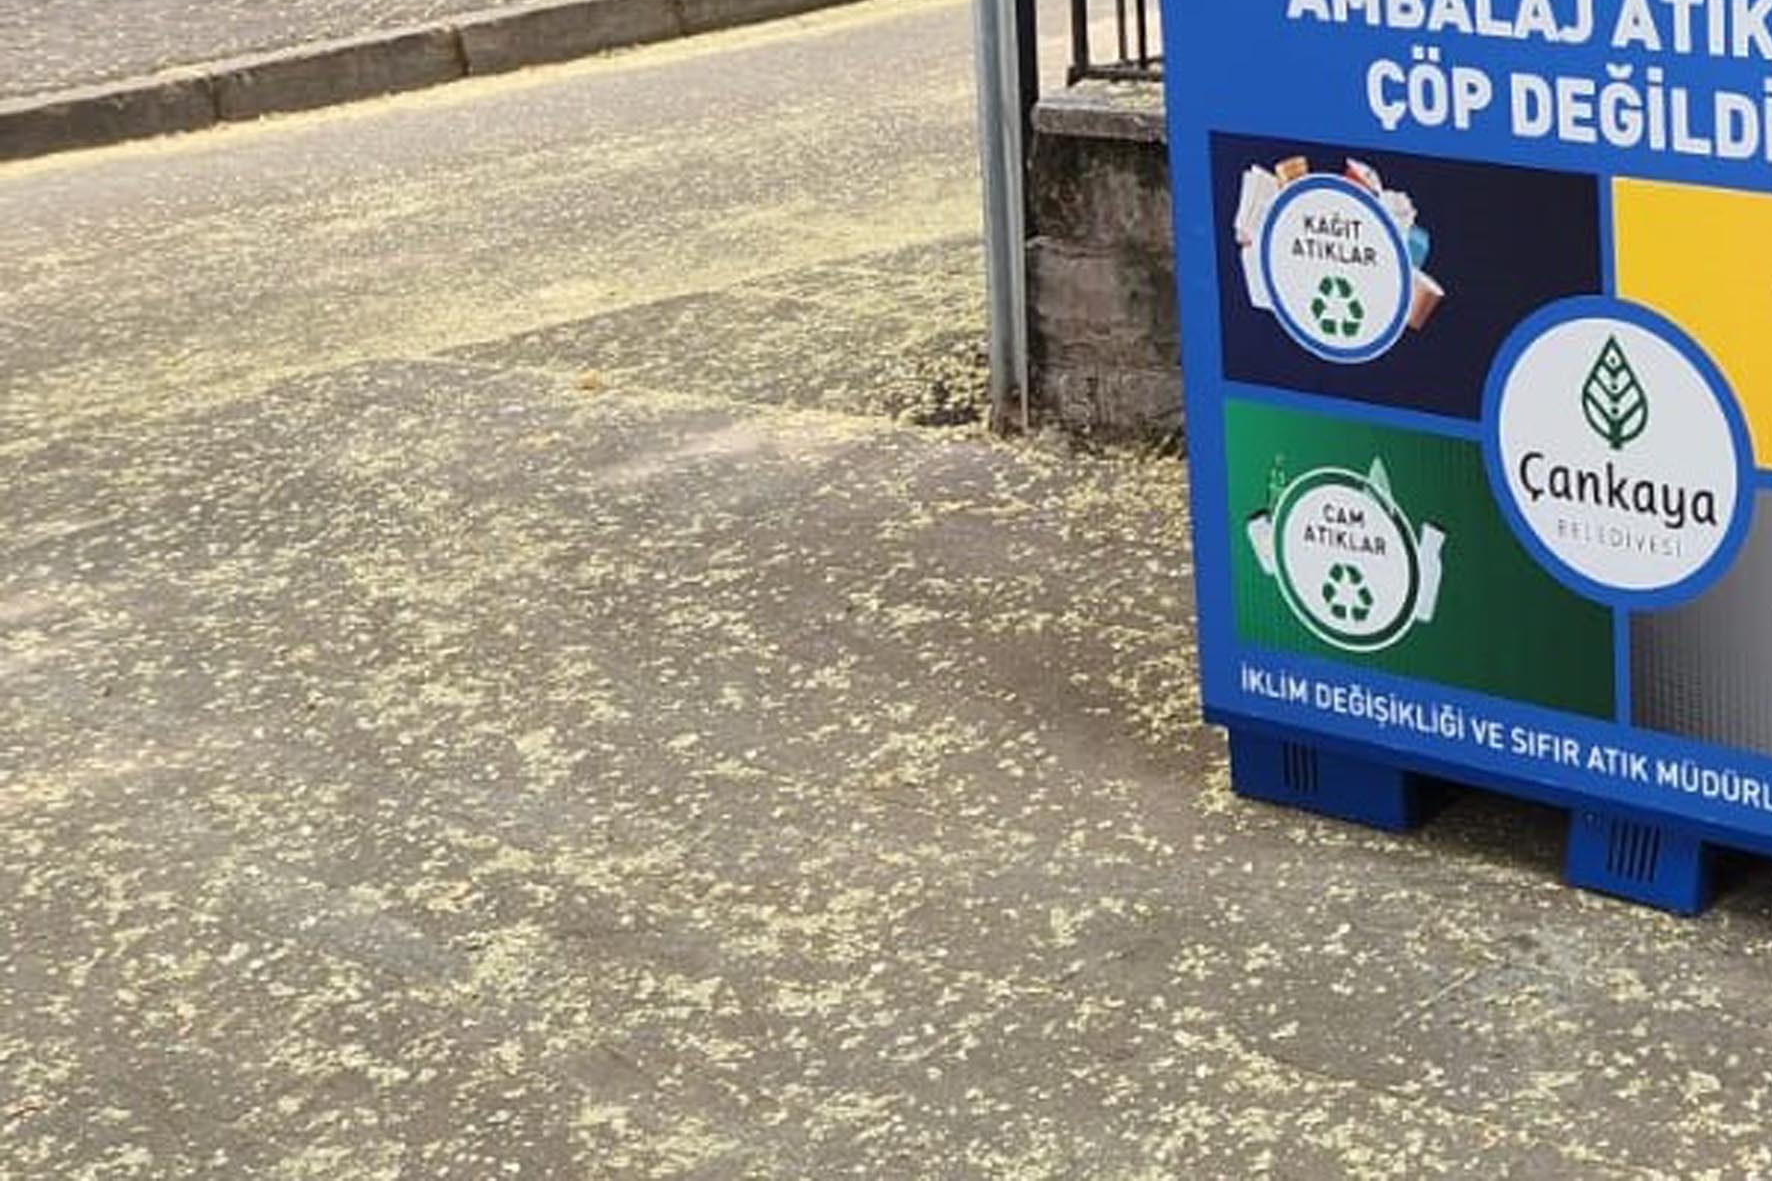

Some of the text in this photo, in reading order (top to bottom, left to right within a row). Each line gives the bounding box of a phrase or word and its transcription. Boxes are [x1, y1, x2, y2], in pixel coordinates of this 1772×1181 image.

[1366, 45, 1493, 132] ÇÖP
[1304, 210, 1363, 241] KAĞIT
[1291, 238, 1378, 268] ATIKLAR
[1518, 450, 1719, 529] Çankaya
[1322, 503, 1366, 530] CAM
[1303, 527, 1388, 557] ATIKLAR
[1556, 517, 1684, 559] BELEDİYESİ
[1241, 662, 1309, 704] İKLİM
[1314, 683, 1467, 742] DEĞİŞİKLİĞİ
[1470, 719, 1505, 750] VE
[1510, 728, 1580, 767] SIFIR
[1587, 746, 1650, 784] ATIK
